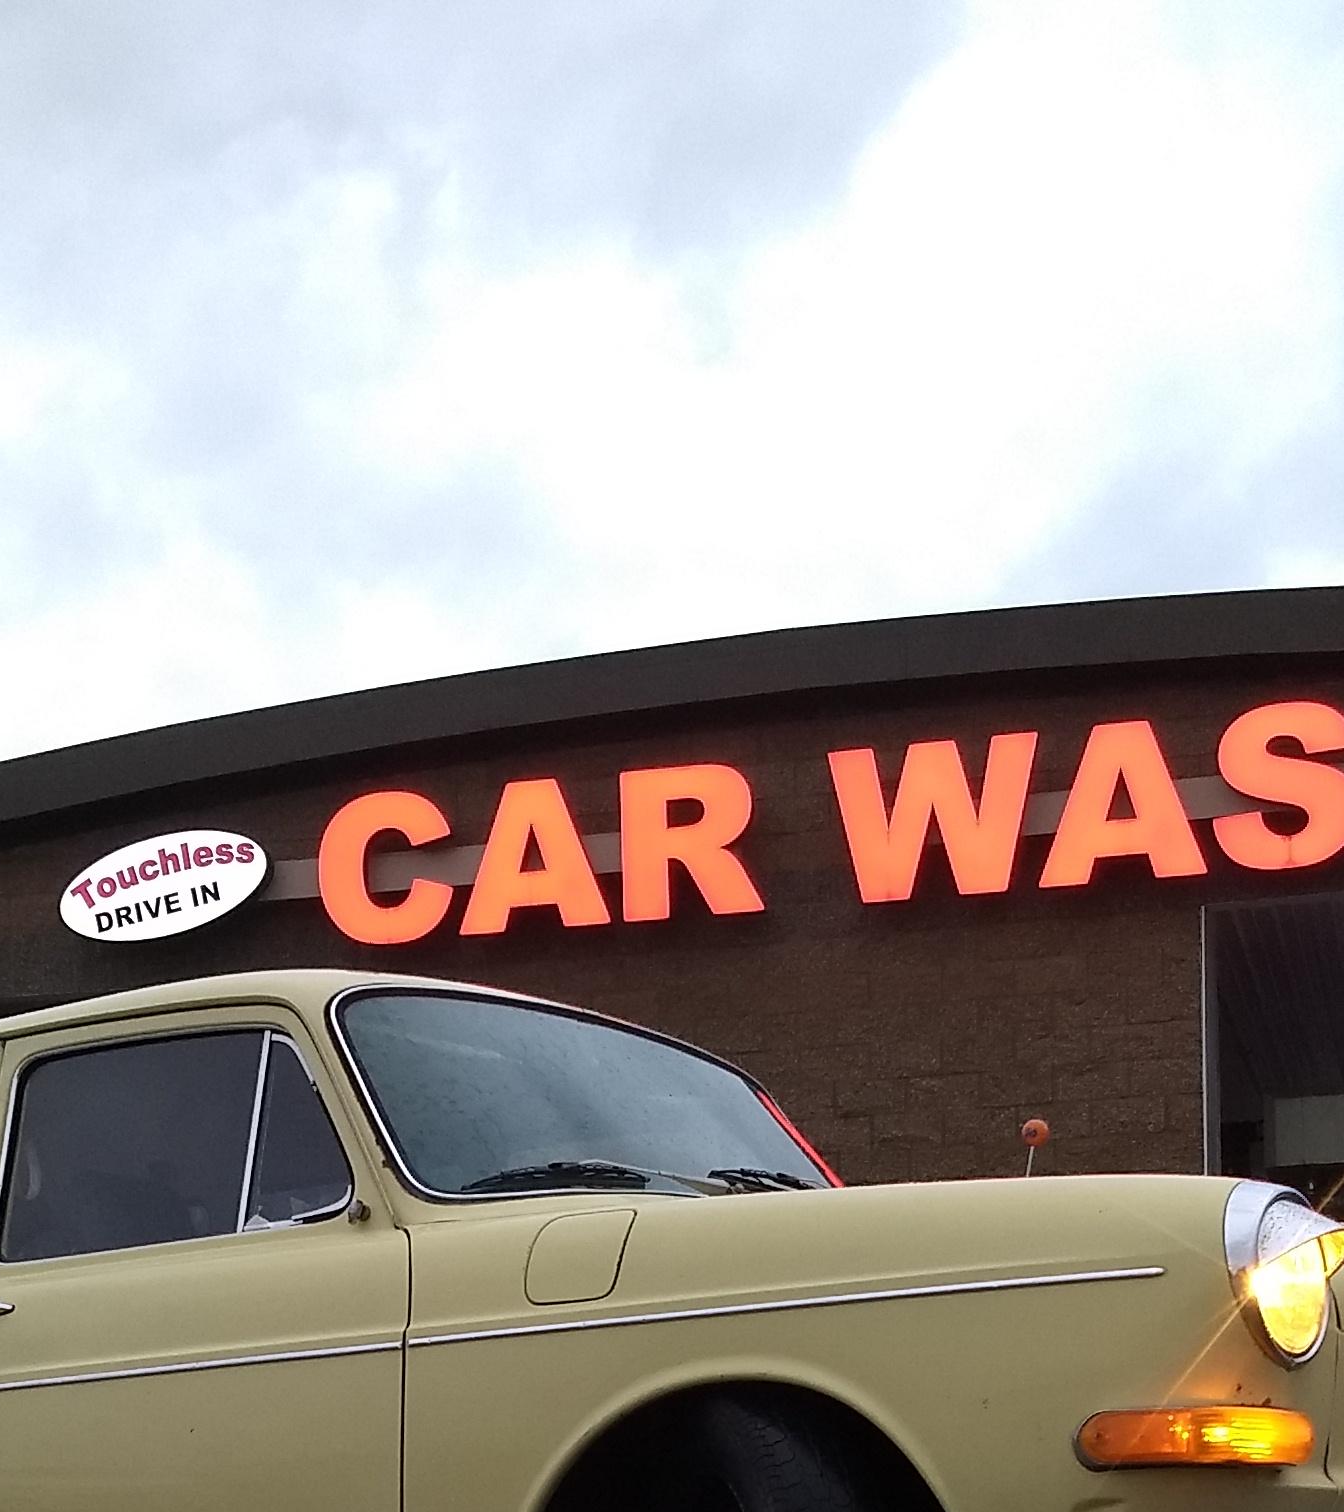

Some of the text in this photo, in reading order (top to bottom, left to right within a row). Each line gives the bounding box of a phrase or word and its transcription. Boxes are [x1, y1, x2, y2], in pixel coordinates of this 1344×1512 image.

[70, 843, 255, 909] Touchless
[317, 764, 765, 944] CAR
[95, 882, 221, 933] DRIVE IN
